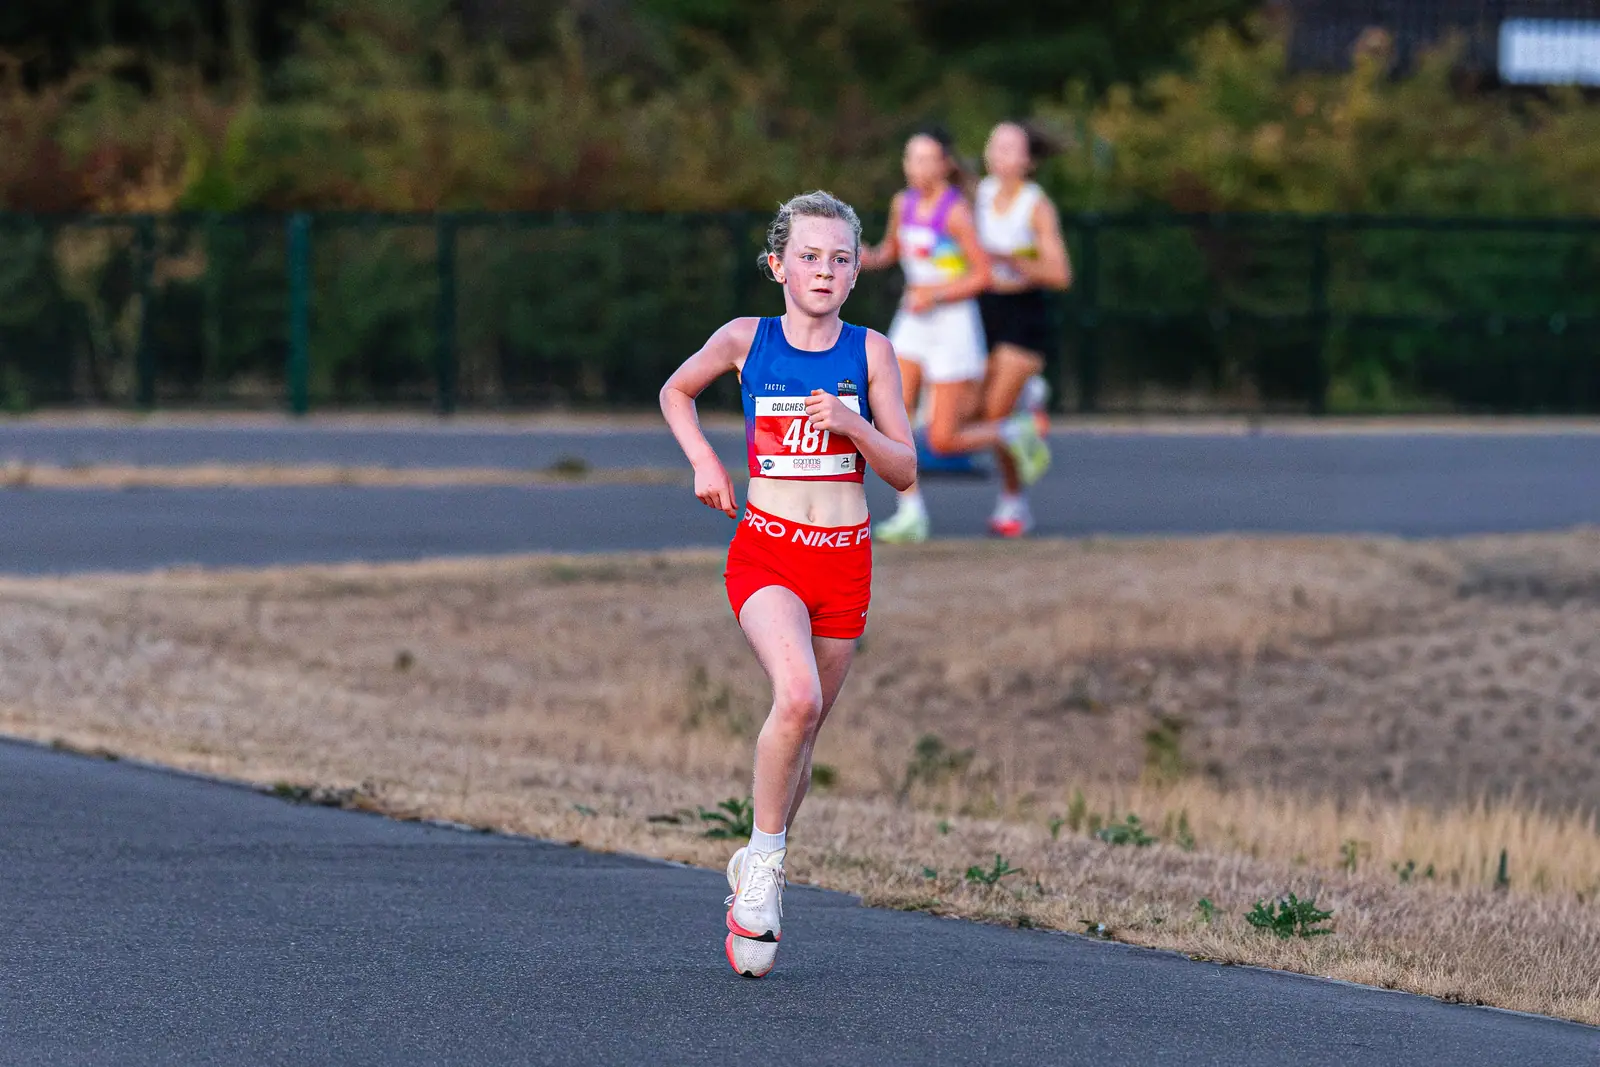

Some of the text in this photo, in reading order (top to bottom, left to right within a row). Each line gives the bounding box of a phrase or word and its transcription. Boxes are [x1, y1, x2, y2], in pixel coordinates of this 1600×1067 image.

[764, 383, 786, 391] TACTIC
[782, 418, 830, 453] 481
[742, 508, 871, 547] PRO NIKE P
